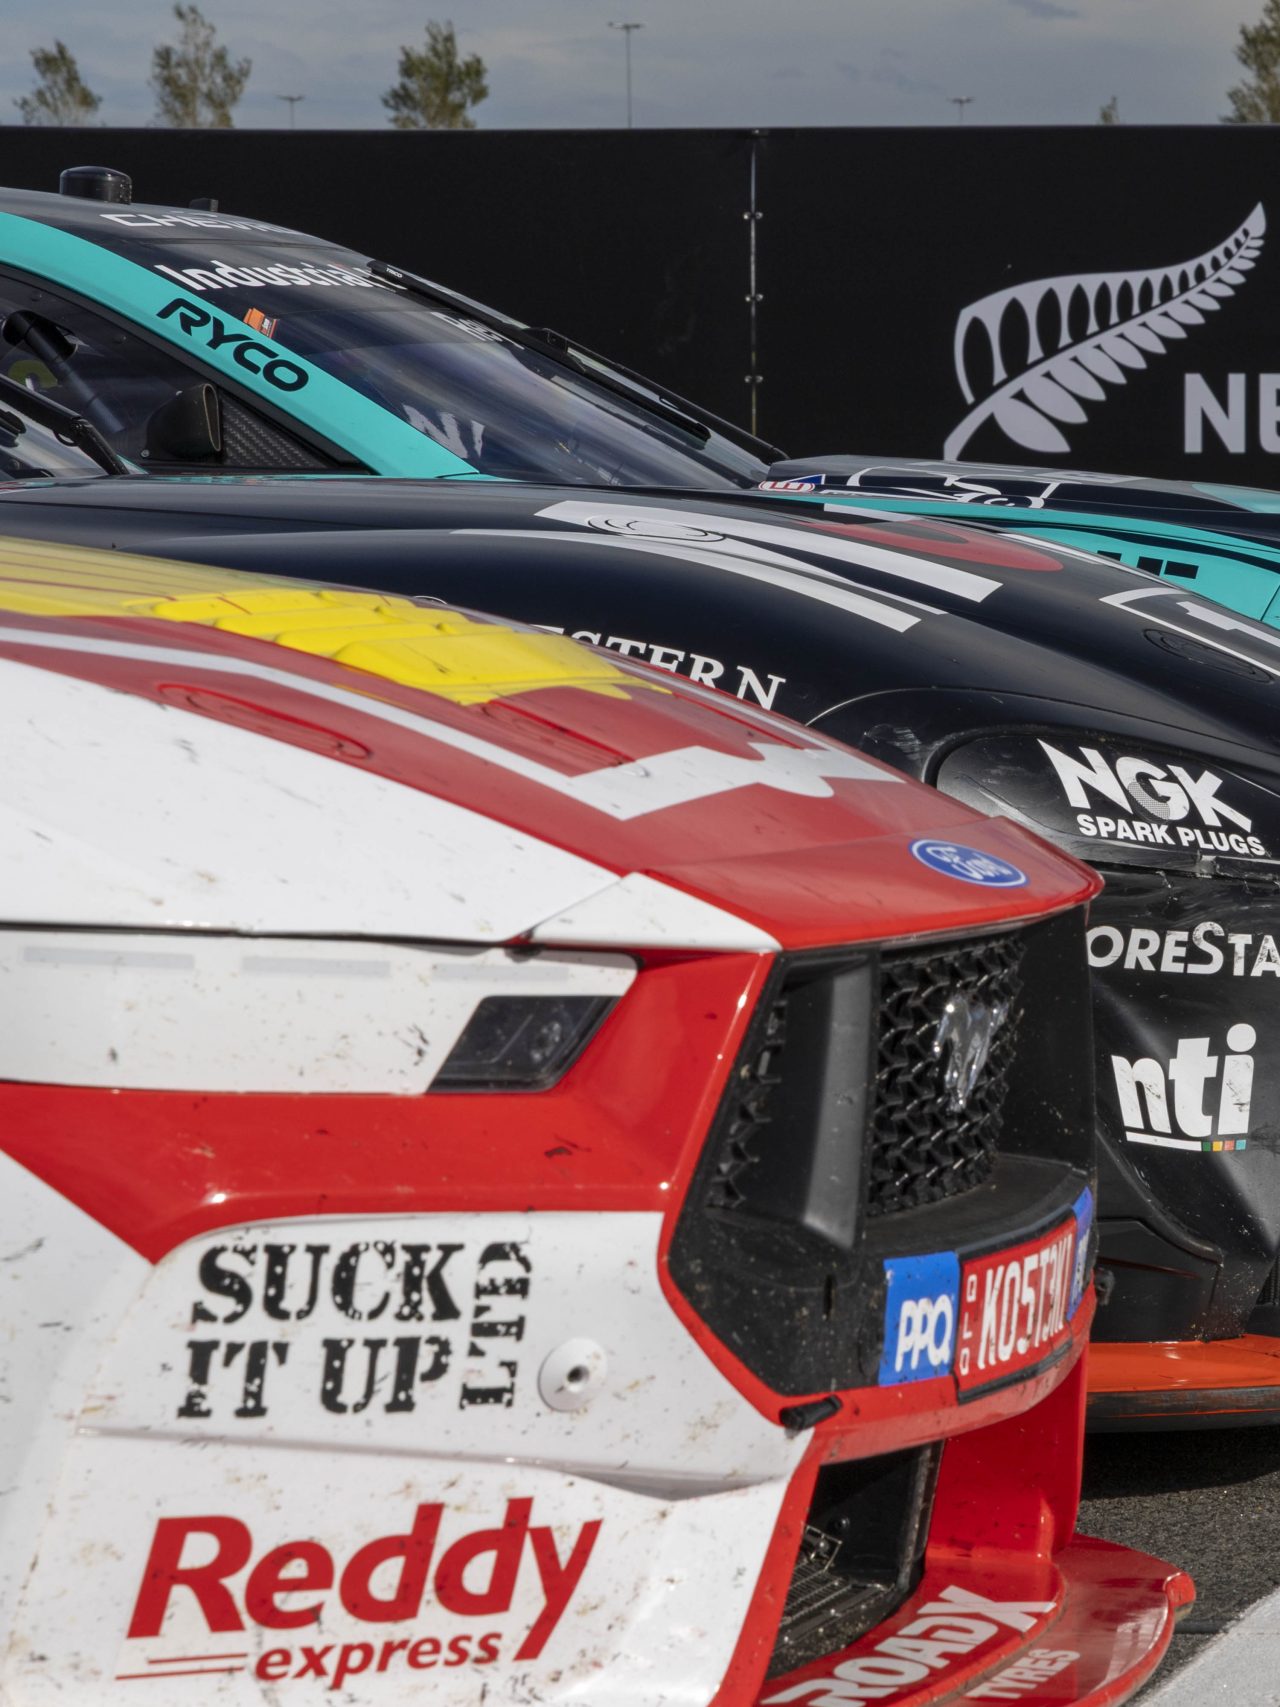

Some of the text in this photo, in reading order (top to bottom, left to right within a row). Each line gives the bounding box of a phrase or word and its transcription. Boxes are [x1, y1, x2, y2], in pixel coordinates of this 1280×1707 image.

[154, 260, 397, 292] Industrial
[156, 297, 310, 392] RYCO
[1036, 738, 1252, 833] NGK
[1076, 813, 1267, 857] SPARK PLUGS
[1110, 1022, 1257, 1138] nti
[191, 1239, 464, 1325] SUCK
[894, 1294, 953, 1373] PPQ
[177, 1335, 454, 1418] IT UP
[126, 1496, 604, 1662] Reddy
[255, 1631, 501, 1690] express
[761, 1584, 1058, 1707] ROADX
[965, 1648, 1081, 1701] TYRES
